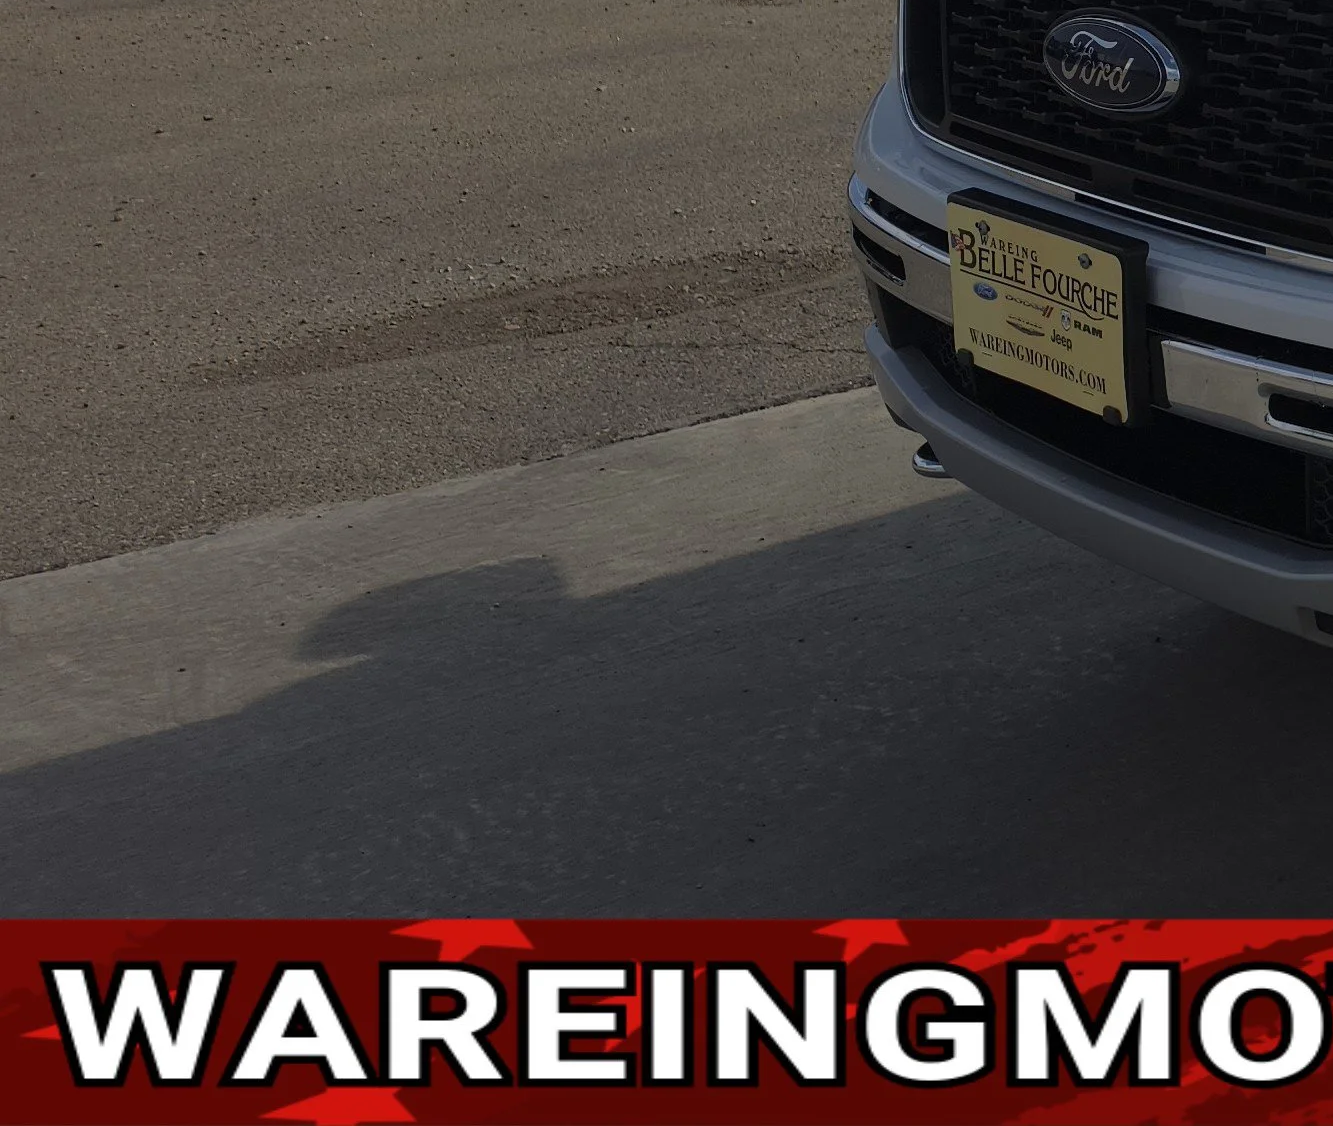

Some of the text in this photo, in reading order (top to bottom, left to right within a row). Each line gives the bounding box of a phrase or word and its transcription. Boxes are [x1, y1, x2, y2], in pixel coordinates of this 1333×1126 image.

[1060, 29, 1136, 95] Ford
[979, 233, 1039, 263] WAREING
[957, 227, 1119, 321] BELLE FOURCHE
[1050, 329, 1073, 352] Jeep
[1073, 320, 1103, 339] RAM
[968, 326, 1107, 395] WAREINGMOTORS.COM
